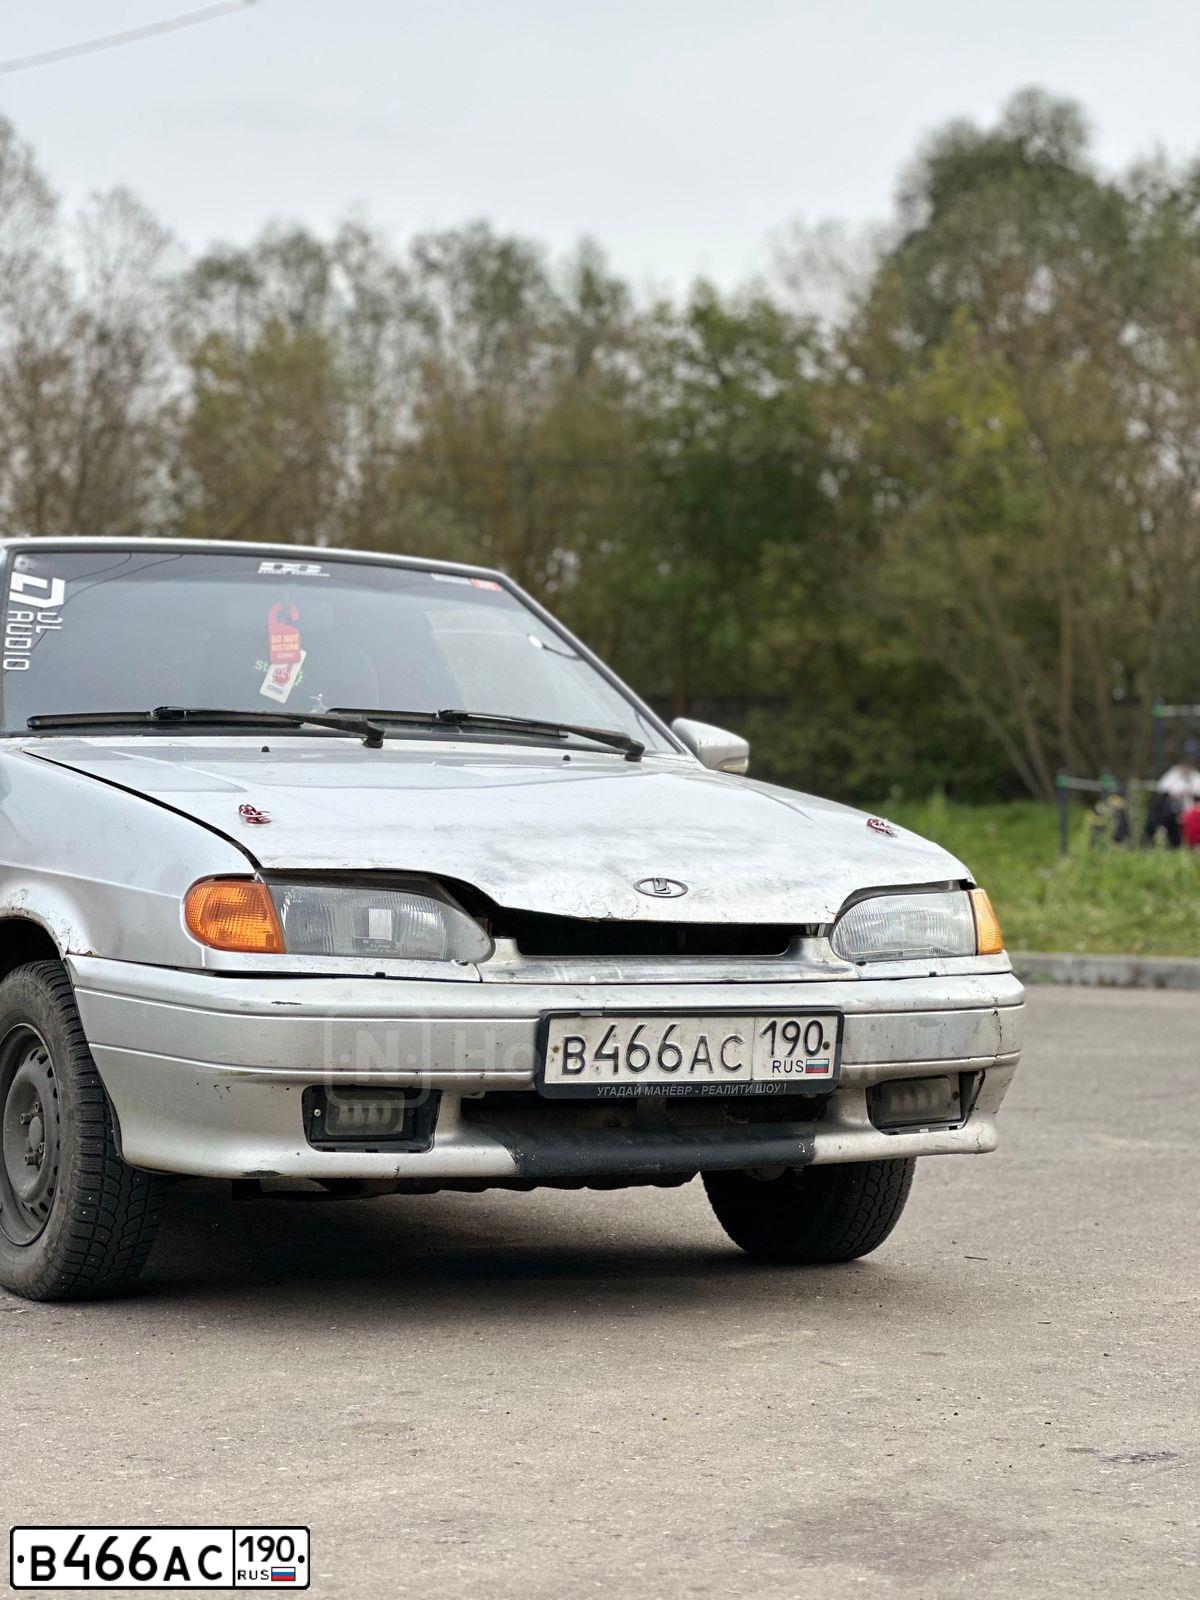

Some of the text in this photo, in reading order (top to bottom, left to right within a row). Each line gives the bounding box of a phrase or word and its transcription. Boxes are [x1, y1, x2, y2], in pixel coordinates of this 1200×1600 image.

[3, 610, 33, 670] AUDIO
[562, 1022, 745, 1075] В466АС
[759, 1019, 823, 1057] 190
[772, 1059, 804, 1074] RUS
[597, 1083, 642, 1097] УГАДАЙ
[644, 1084, 692, 1096] МАНЁВР
[701, 1084, 752, 1095] РЕАЛИТИ
[755, 1083, 781, 1094] ШОУ
